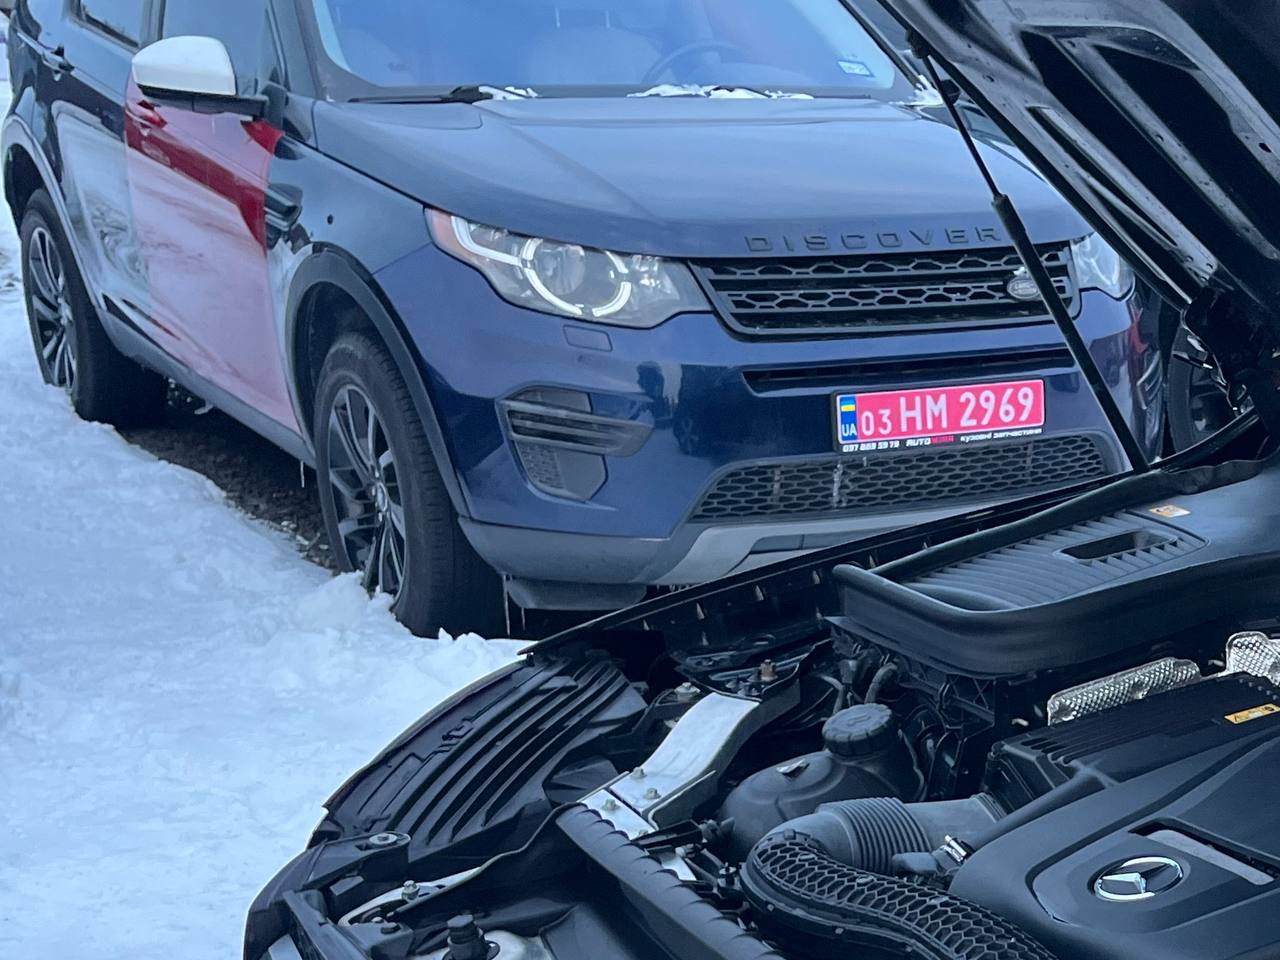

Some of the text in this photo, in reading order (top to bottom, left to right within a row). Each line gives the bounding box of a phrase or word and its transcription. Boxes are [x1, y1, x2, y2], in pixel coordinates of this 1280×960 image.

[744, 226, 1001, 251] DISCOVER
[860, 385, 1035, 437] 03 HM 2969
[841, 423, 858, 437] UA
